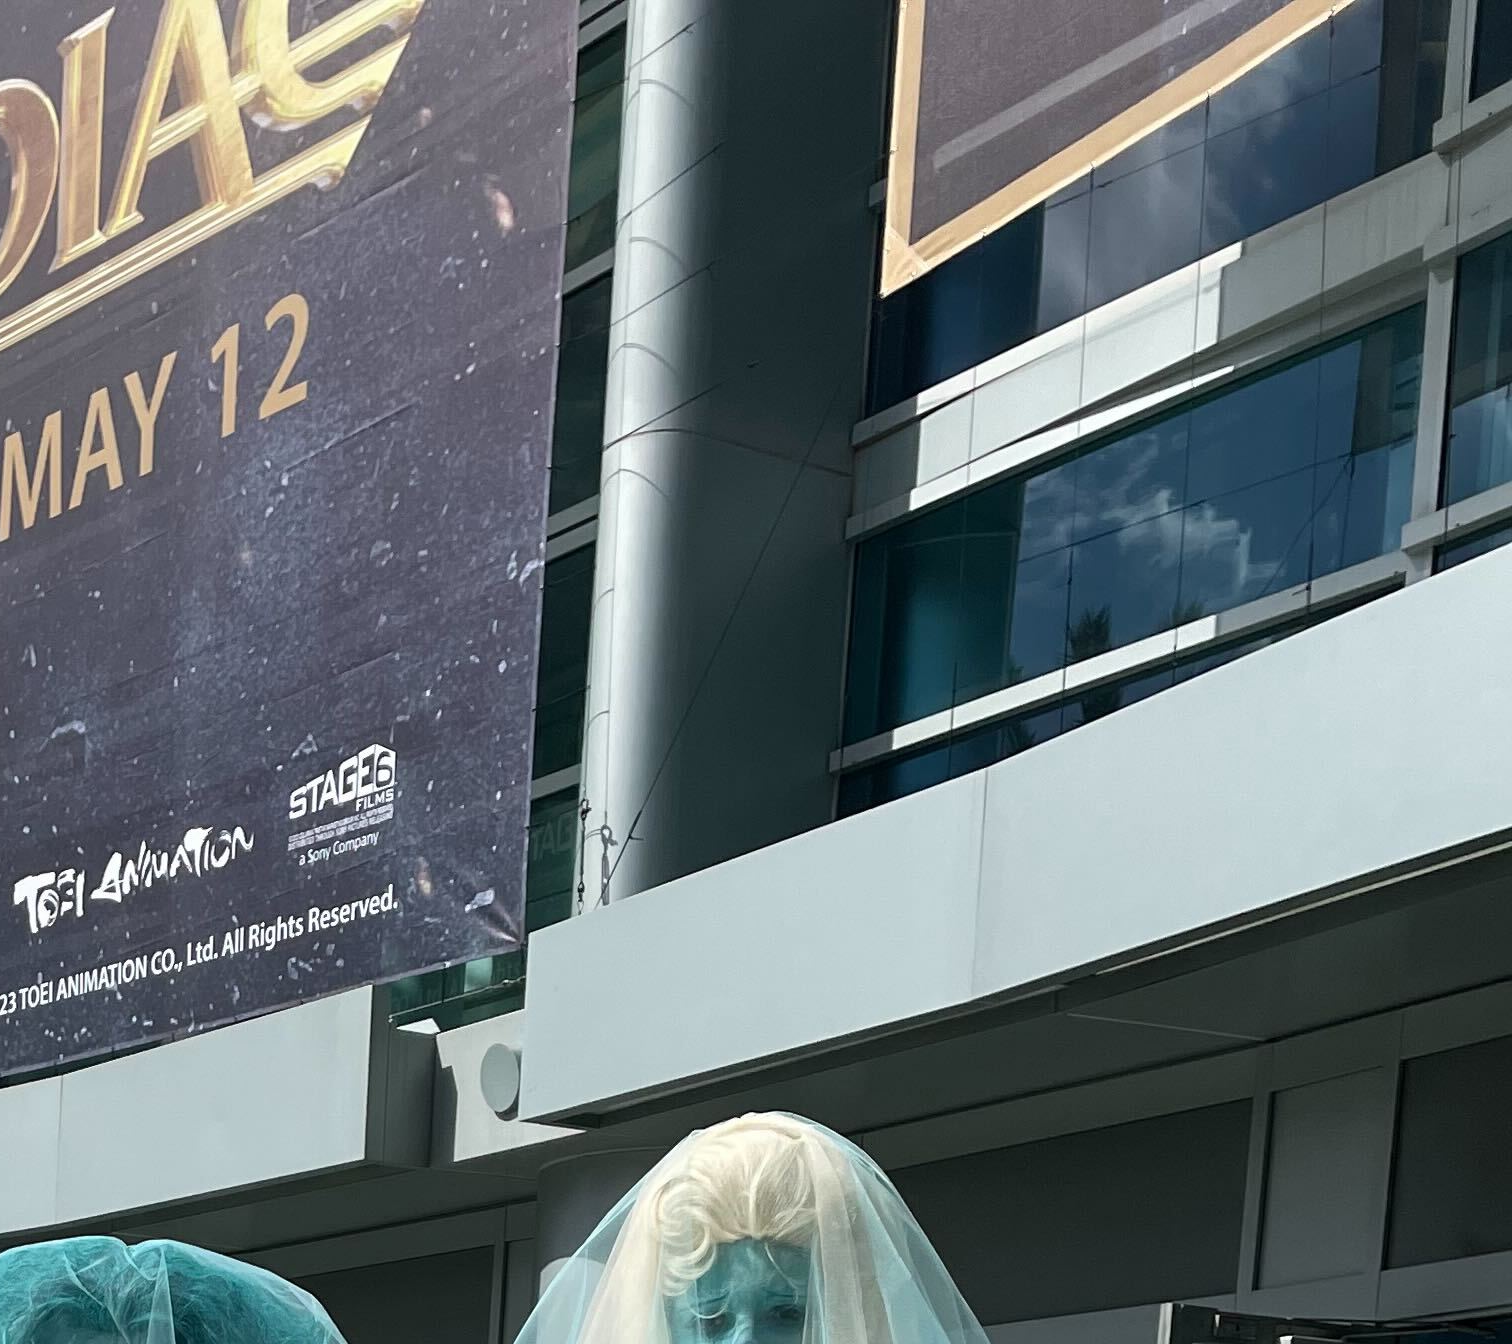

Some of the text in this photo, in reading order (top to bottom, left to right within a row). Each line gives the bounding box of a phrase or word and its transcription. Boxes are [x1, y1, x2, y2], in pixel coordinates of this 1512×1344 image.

[210, 292, 310, 439] 12
[355, 788, 394, 812] FILMS
[298, 831, 380, 866] a Sony Company
[13, 868, 85, 934] TOEI
[19, 980, 53, 1011] TOEI
[56, 955, 148, 1001] ANIMATION
[151, 948, 183, 976] CO.,
[186, 935, 218, 967] Ltd.
[221, 926, 245, 957] All
[249, 915, 304, 951] Rights
[308, 883, 399, 933] Reserved.
